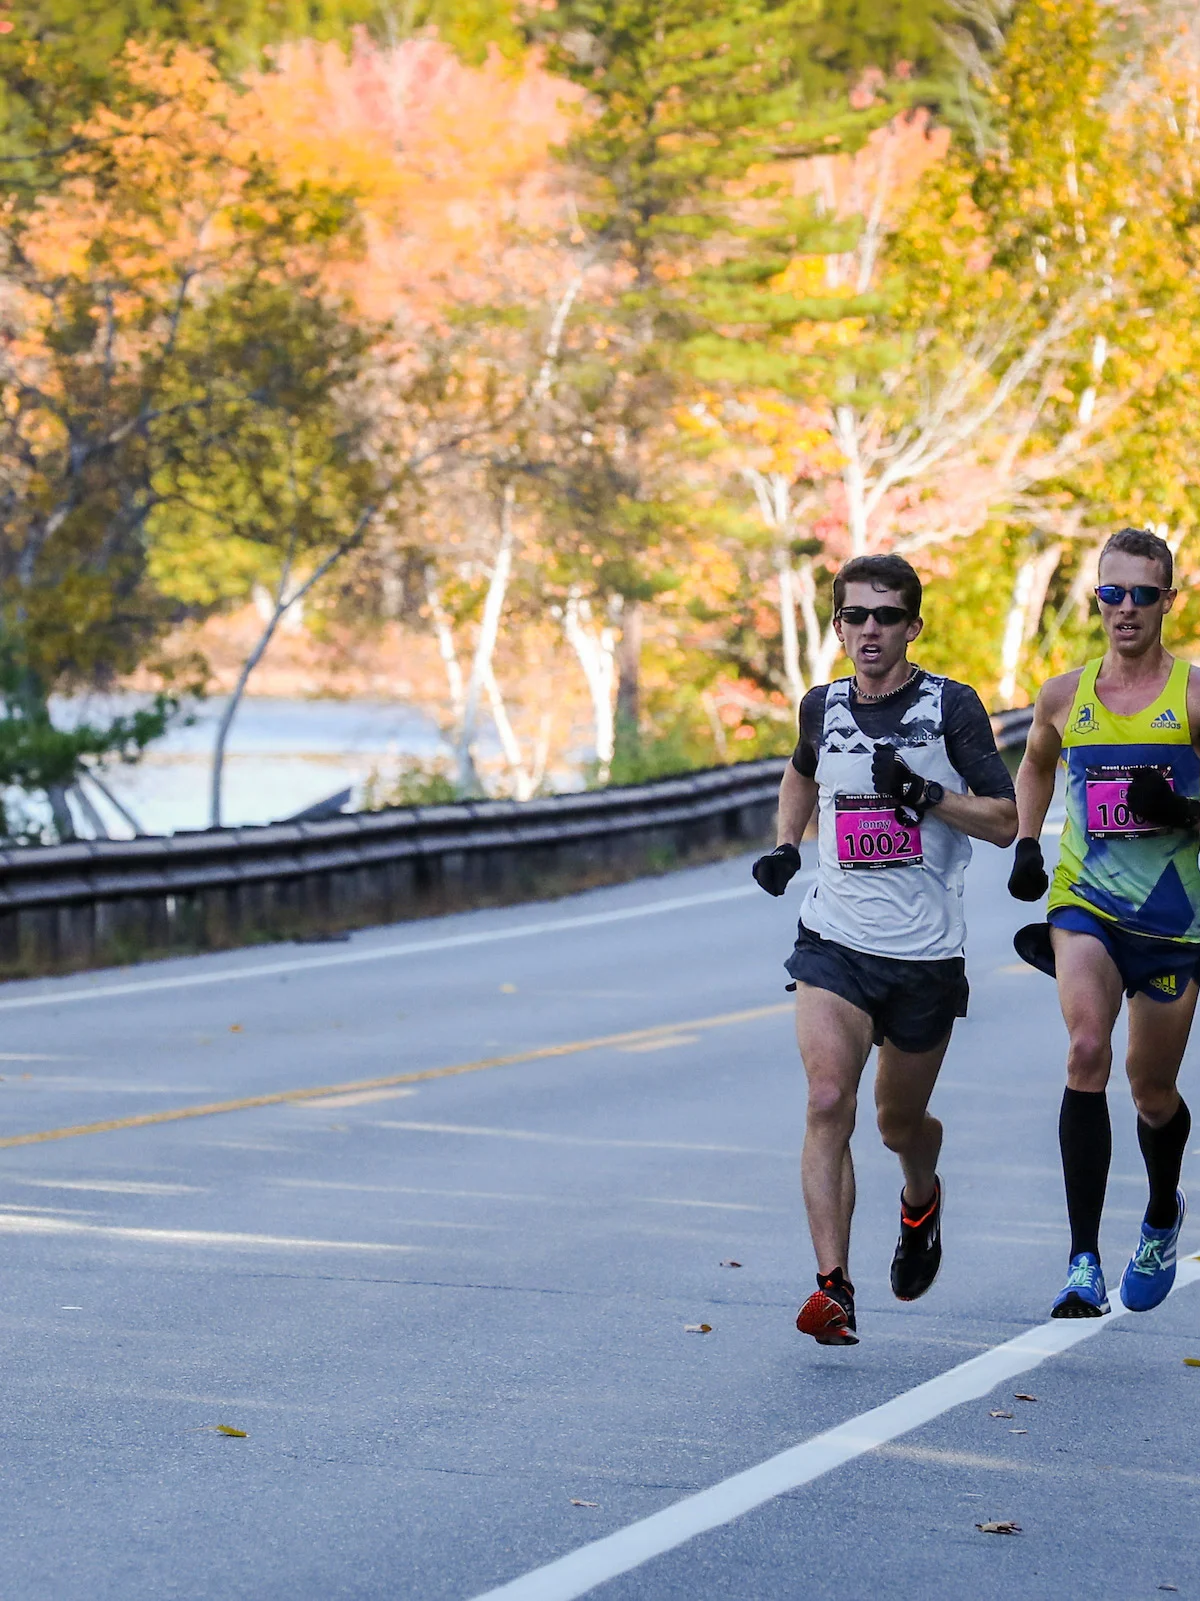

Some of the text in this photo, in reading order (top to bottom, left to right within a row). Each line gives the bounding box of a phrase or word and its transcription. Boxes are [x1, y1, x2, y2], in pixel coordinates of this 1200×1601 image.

[1150, 720, 1181, 729] adidas
[858, 819, 891, 831] Jonny
[844, 831, 913, 857] 1002
[1149, 978, 1177, 995] adidas
